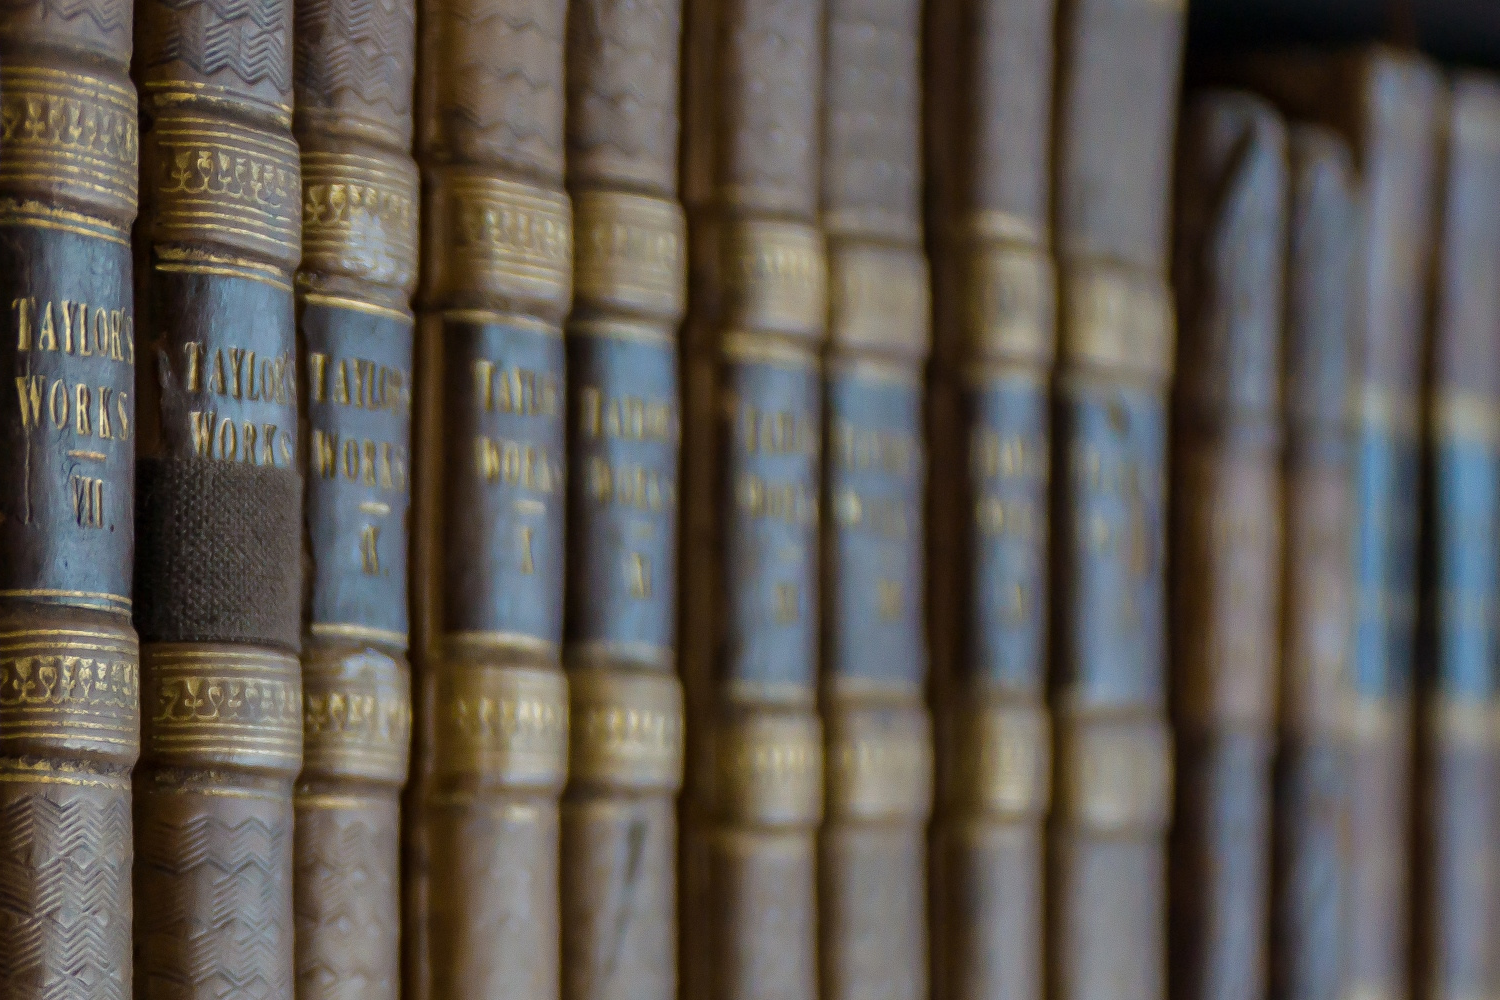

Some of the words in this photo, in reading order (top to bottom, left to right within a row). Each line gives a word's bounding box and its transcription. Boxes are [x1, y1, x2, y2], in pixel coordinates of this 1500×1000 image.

[11, 296, 135, 365] TAYLOR'S
[14, 374, 130, 442] WORKS
[189, 410, 292, 467] WORKS
